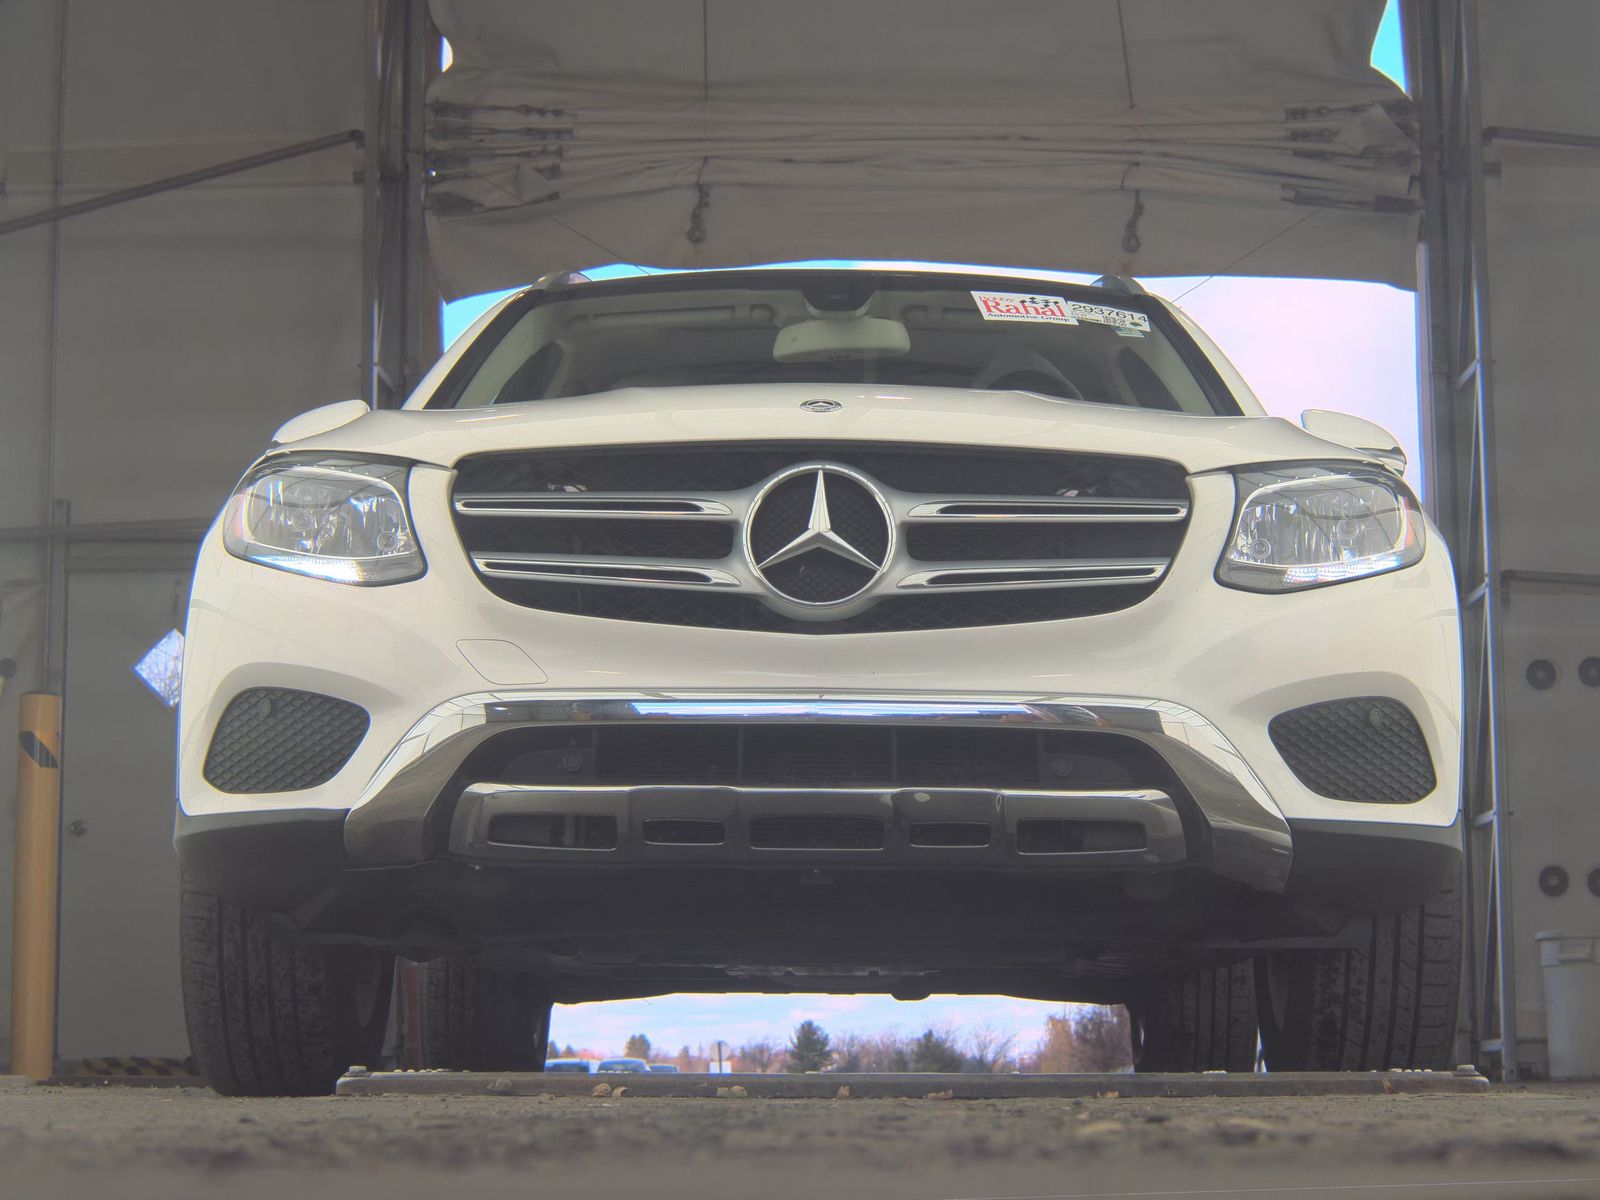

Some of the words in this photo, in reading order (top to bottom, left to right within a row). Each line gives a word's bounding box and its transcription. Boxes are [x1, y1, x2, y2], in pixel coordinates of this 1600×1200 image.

[981, 299, 1067, 317] Rahal
[987, 312, 1039, 320] Automotive
[1071, 303, 1147, 322] 2937614
